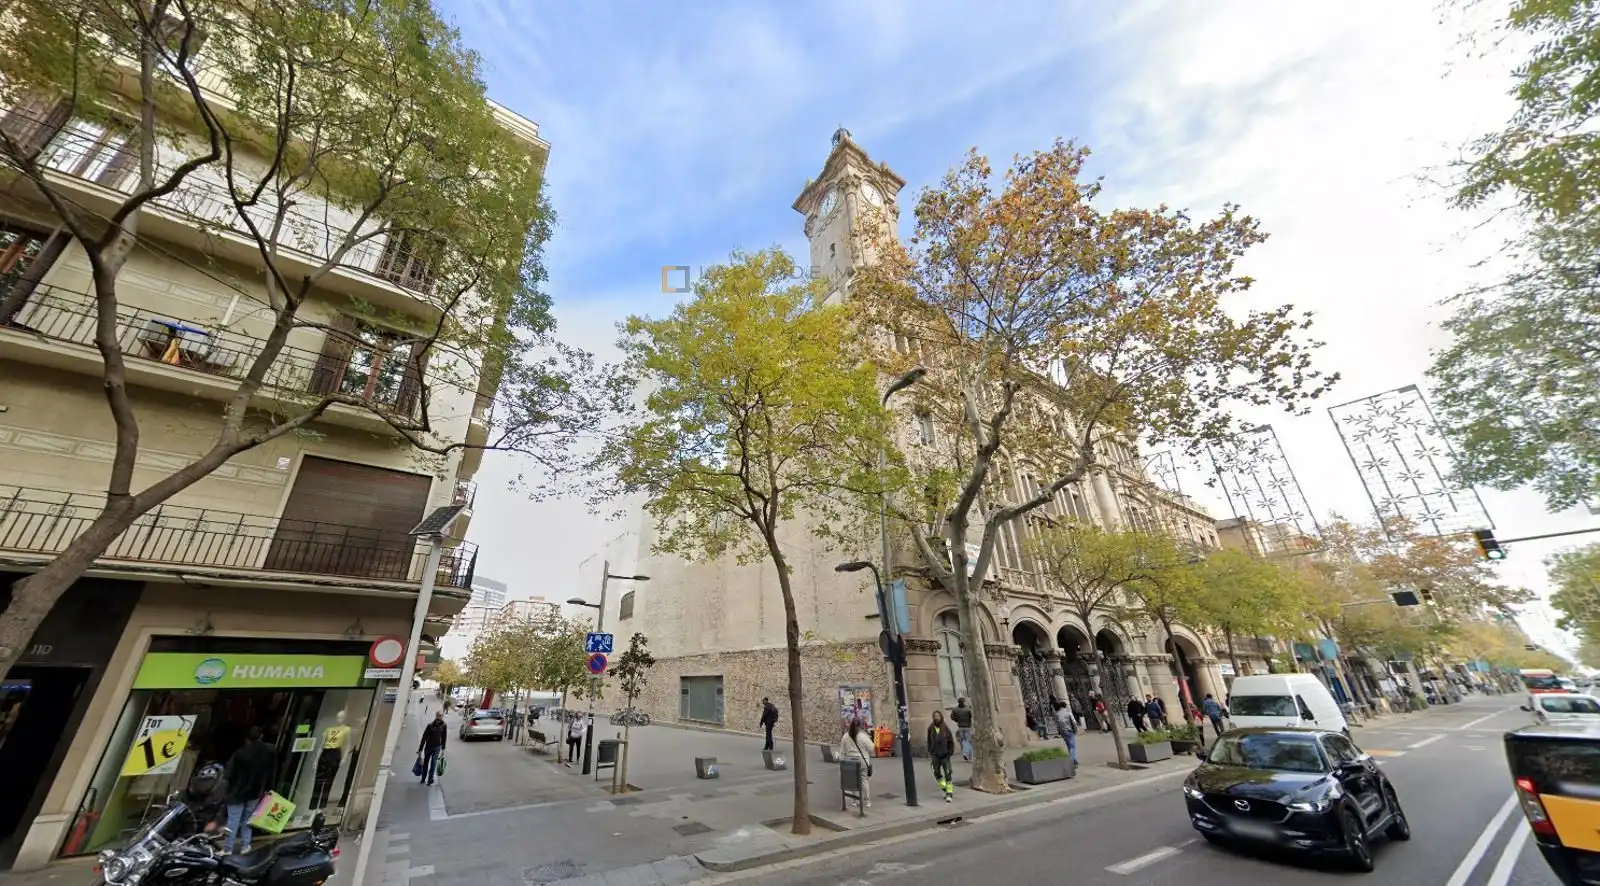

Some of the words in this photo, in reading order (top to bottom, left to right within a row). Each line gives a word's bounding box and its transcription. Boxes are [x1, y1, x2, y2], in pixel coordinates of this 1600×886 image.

[30, 644, 53, 655] 110
[231, 664, 325, 678] HUMANA
[145, 718, 163, 729] TOT
